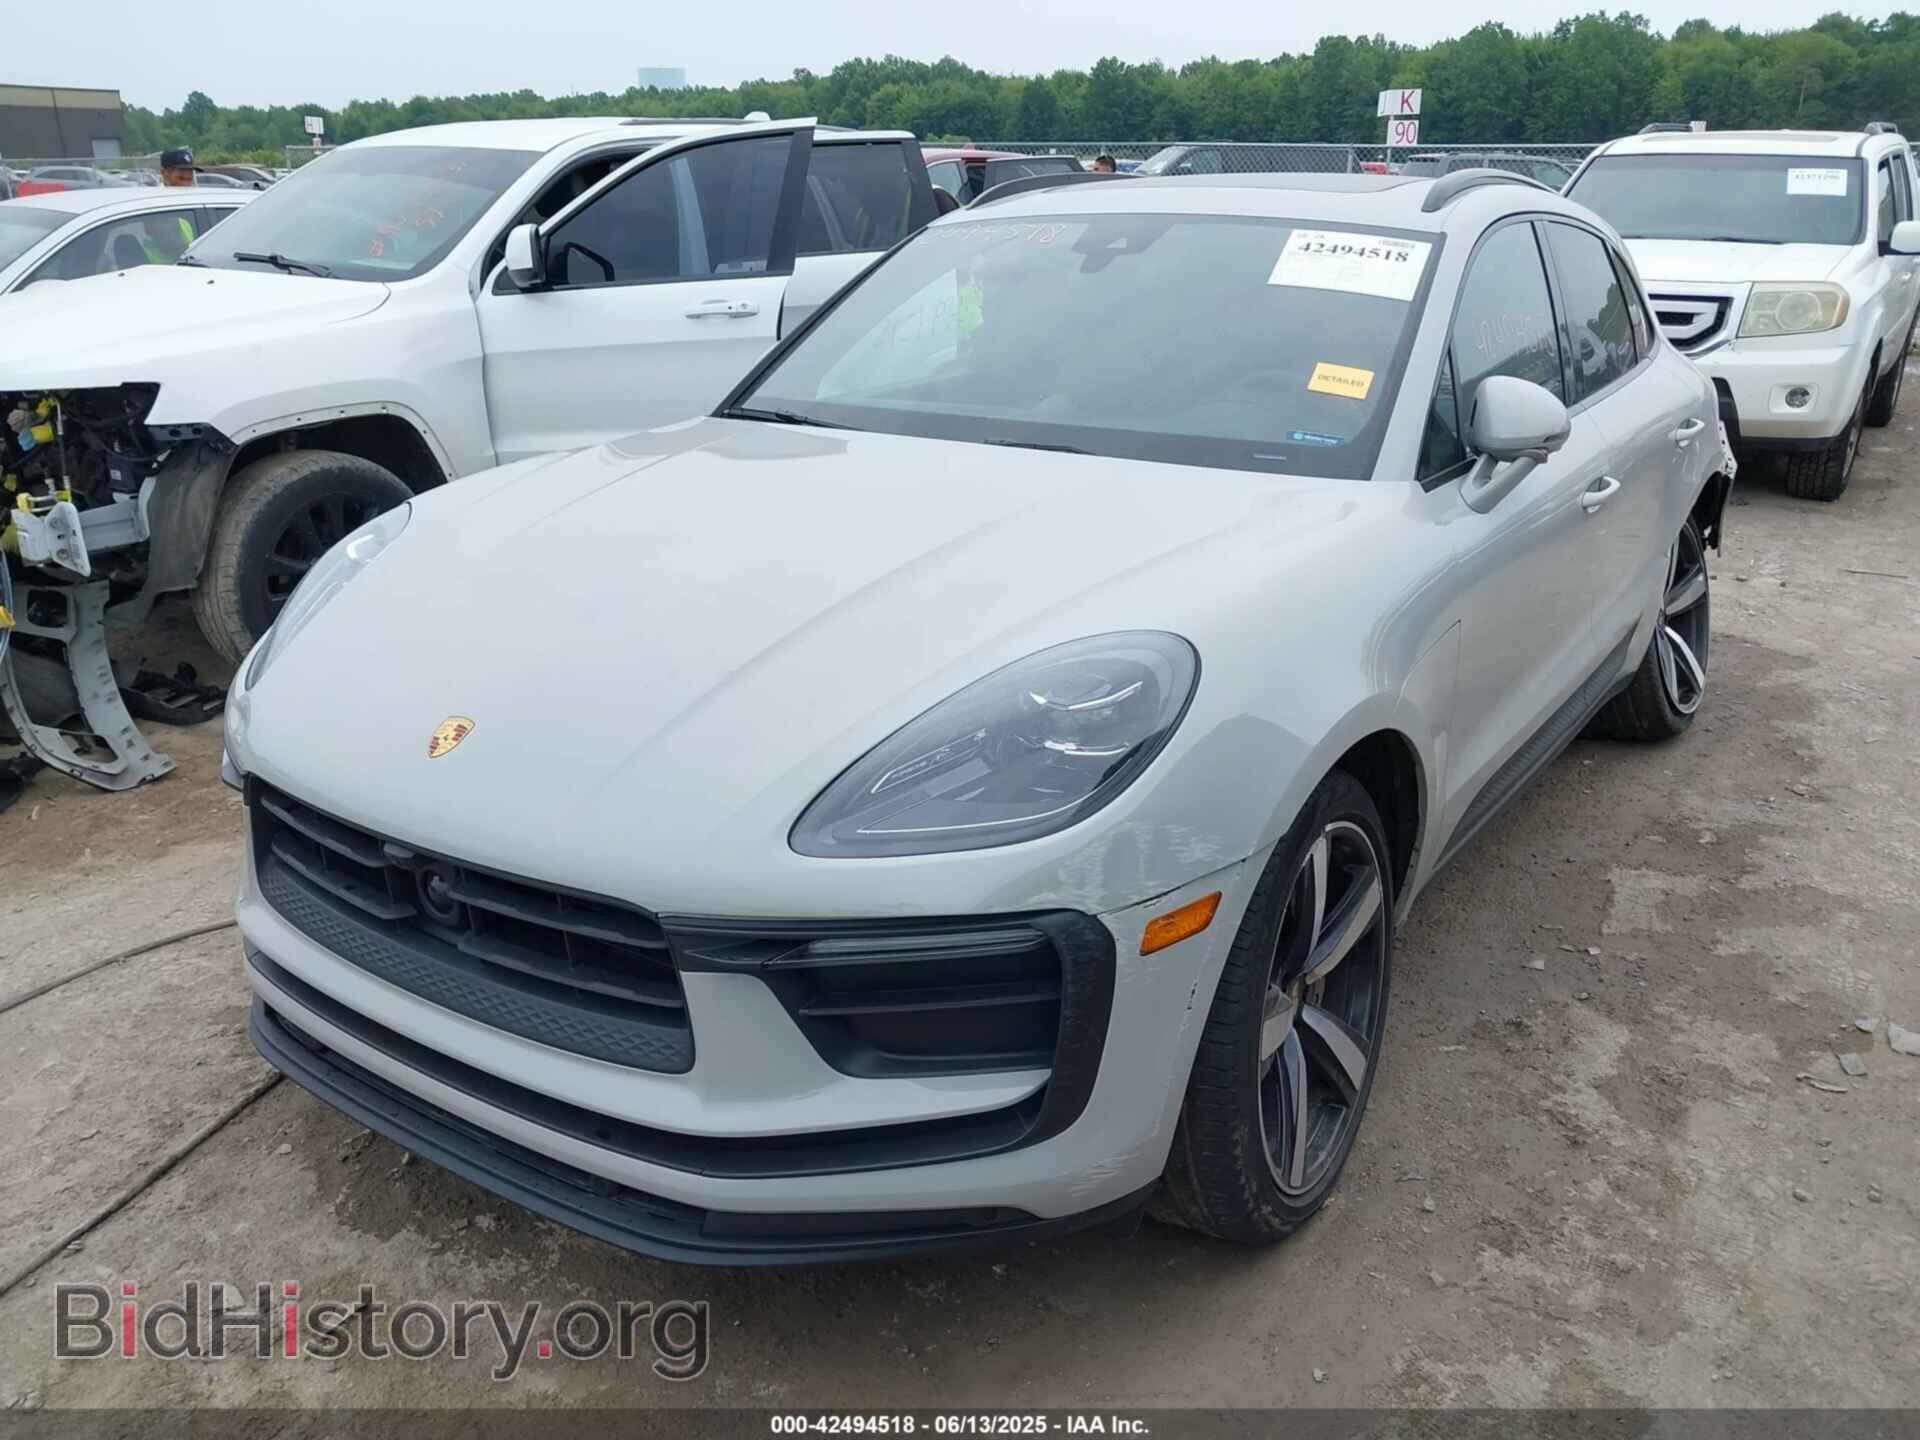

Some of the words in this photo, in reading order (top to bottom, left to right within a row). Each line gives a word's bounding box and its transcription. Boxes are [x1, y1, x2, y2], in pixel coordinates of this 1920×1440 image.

[1400, 90, 1414, 113] K
[1395, 121, 1417, 145] 90
[1299, 241, 1410, 263] 42494518
[1317, 374, 1365, 388] DETAILED
